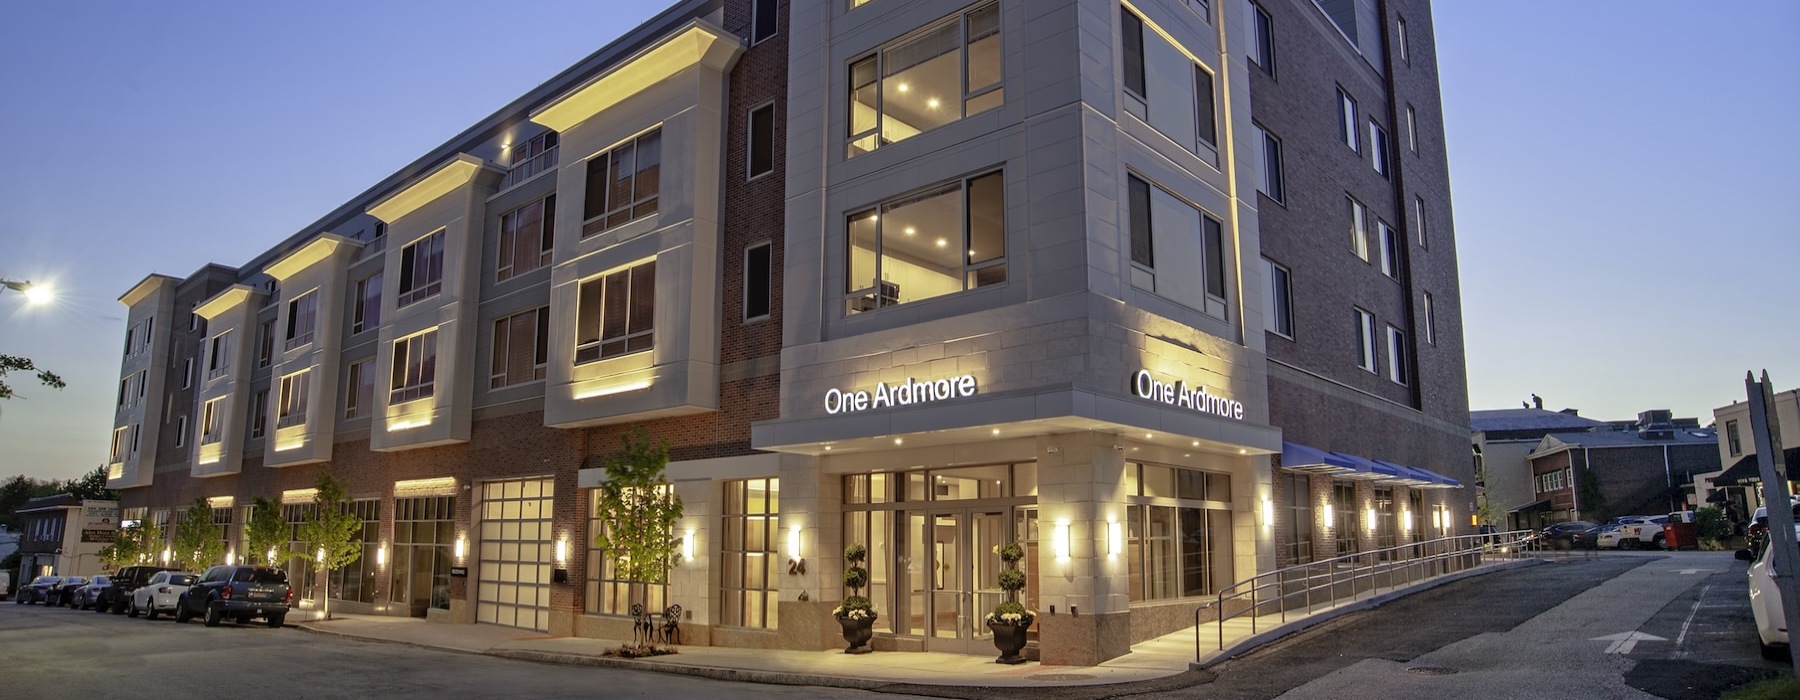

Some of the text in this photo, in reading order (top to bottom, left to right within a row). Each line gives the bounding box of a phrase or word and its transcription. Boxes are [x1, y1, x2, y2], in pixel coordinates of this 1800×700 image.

[825, 374, 976, 414] One Ardmore
[1137, 369, 1244, 420] One Ardmore
[788, 558, 806, 576] 24
